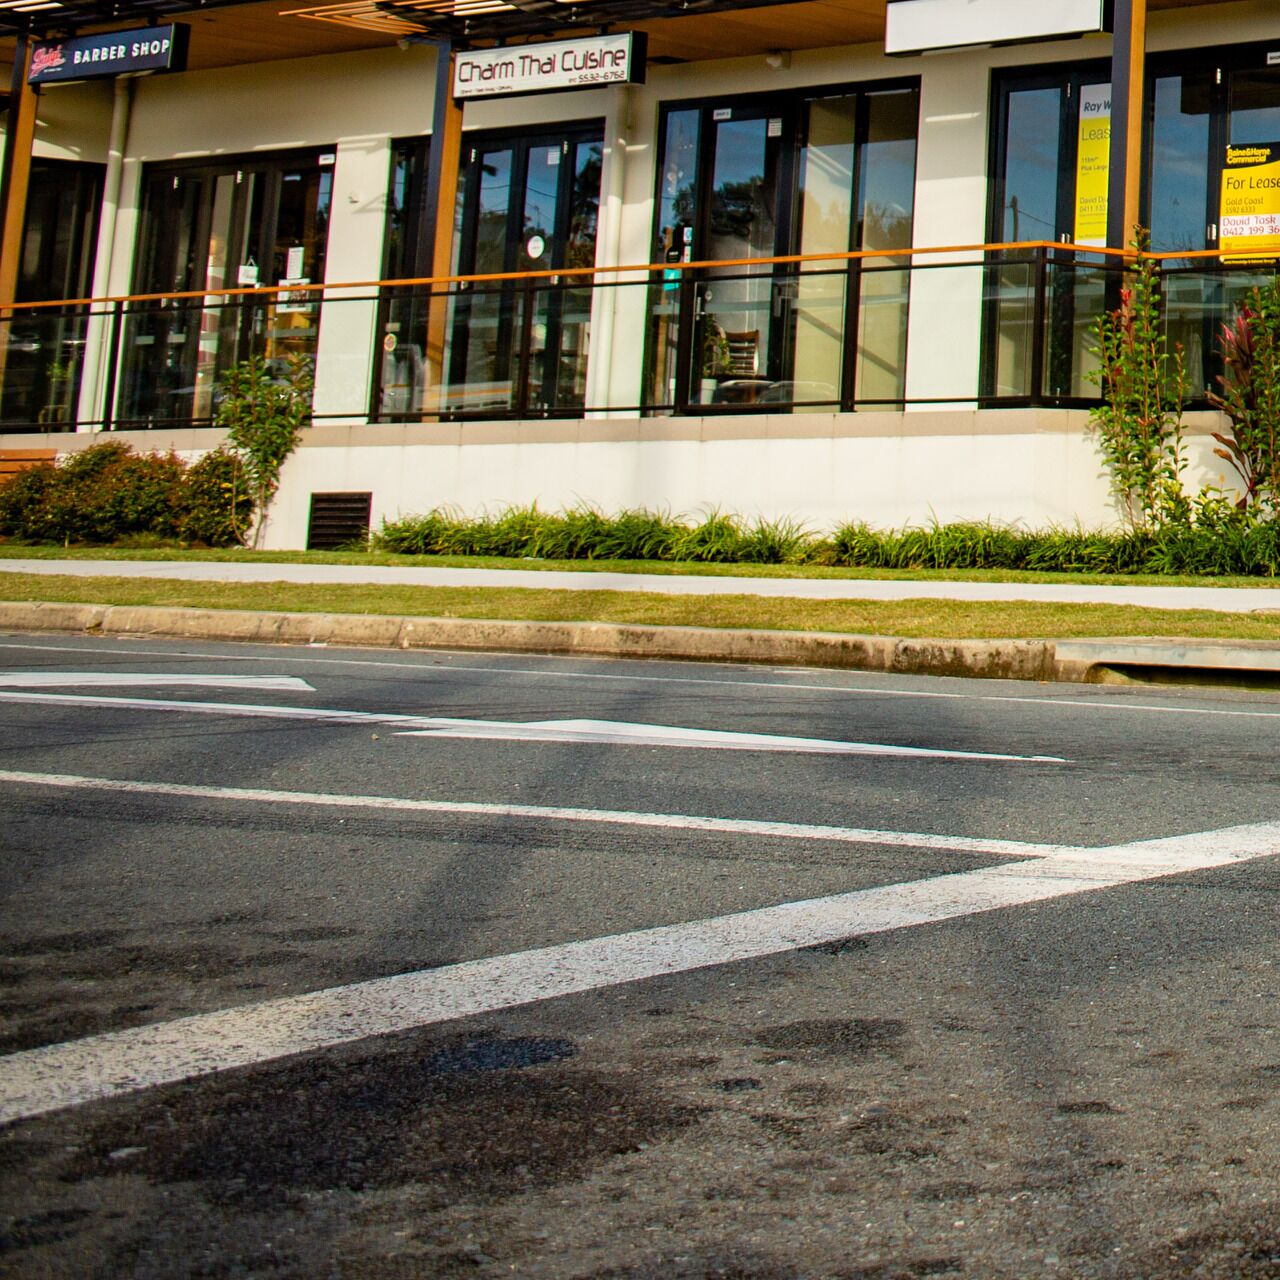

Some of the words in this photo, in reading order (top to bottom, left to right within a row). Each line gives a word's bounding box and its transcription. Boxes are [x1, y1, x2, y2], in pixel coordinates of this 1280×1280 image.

[73, 45, 126, 65] BARBER
[131, 39, 170, 58] SHOP
[459, 61, 514, 83] Charm
[519, 53, 556, 76] Thai
[561, 48, 626, 72] Cuisine
[1083, 102, 1102, 112] Ray
[1081, 127, 1111, 141] Leas
[1226, 176, 1246, 190] For
[1225, 197, 1243, 207] Gold
[1244, 196, 1264, 205] Coast
[1222, 215, 1250, 227] David
[1254, 214, 1277, 225] Task
[1222, 226, 1245, 236] 0412
[1248, 225, 1265, 235] 199
